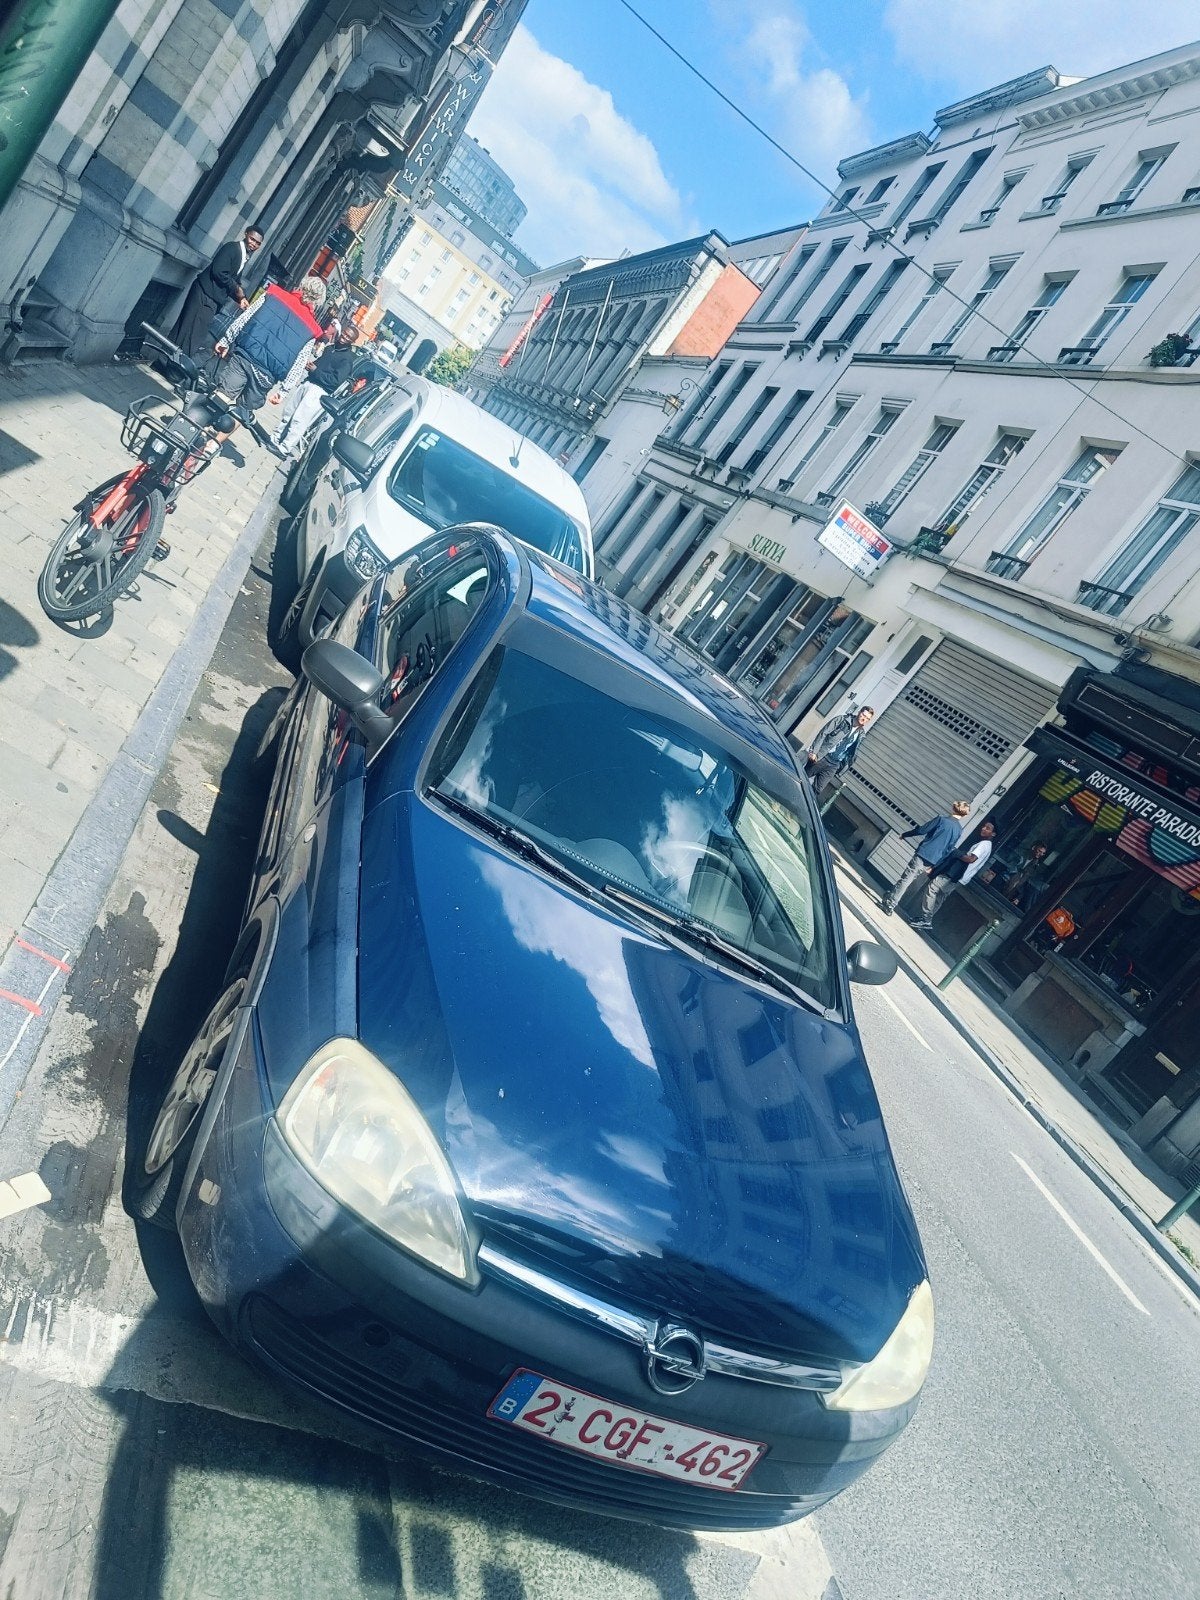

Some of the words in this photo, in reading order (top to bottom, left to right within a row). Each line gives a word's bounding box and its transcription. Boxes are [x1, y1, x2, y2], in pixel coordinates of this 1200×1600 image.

[414, 83, 471, 168] WARWICK
[847, 514, 883, 549] WELCOME
[860, 538, 876, 554] SHOP
[748, 533, 787, 564] SURIYA
[1086, 770, 1158, 818] RISTORANTE
[498, 1397, 518, 1414] B
